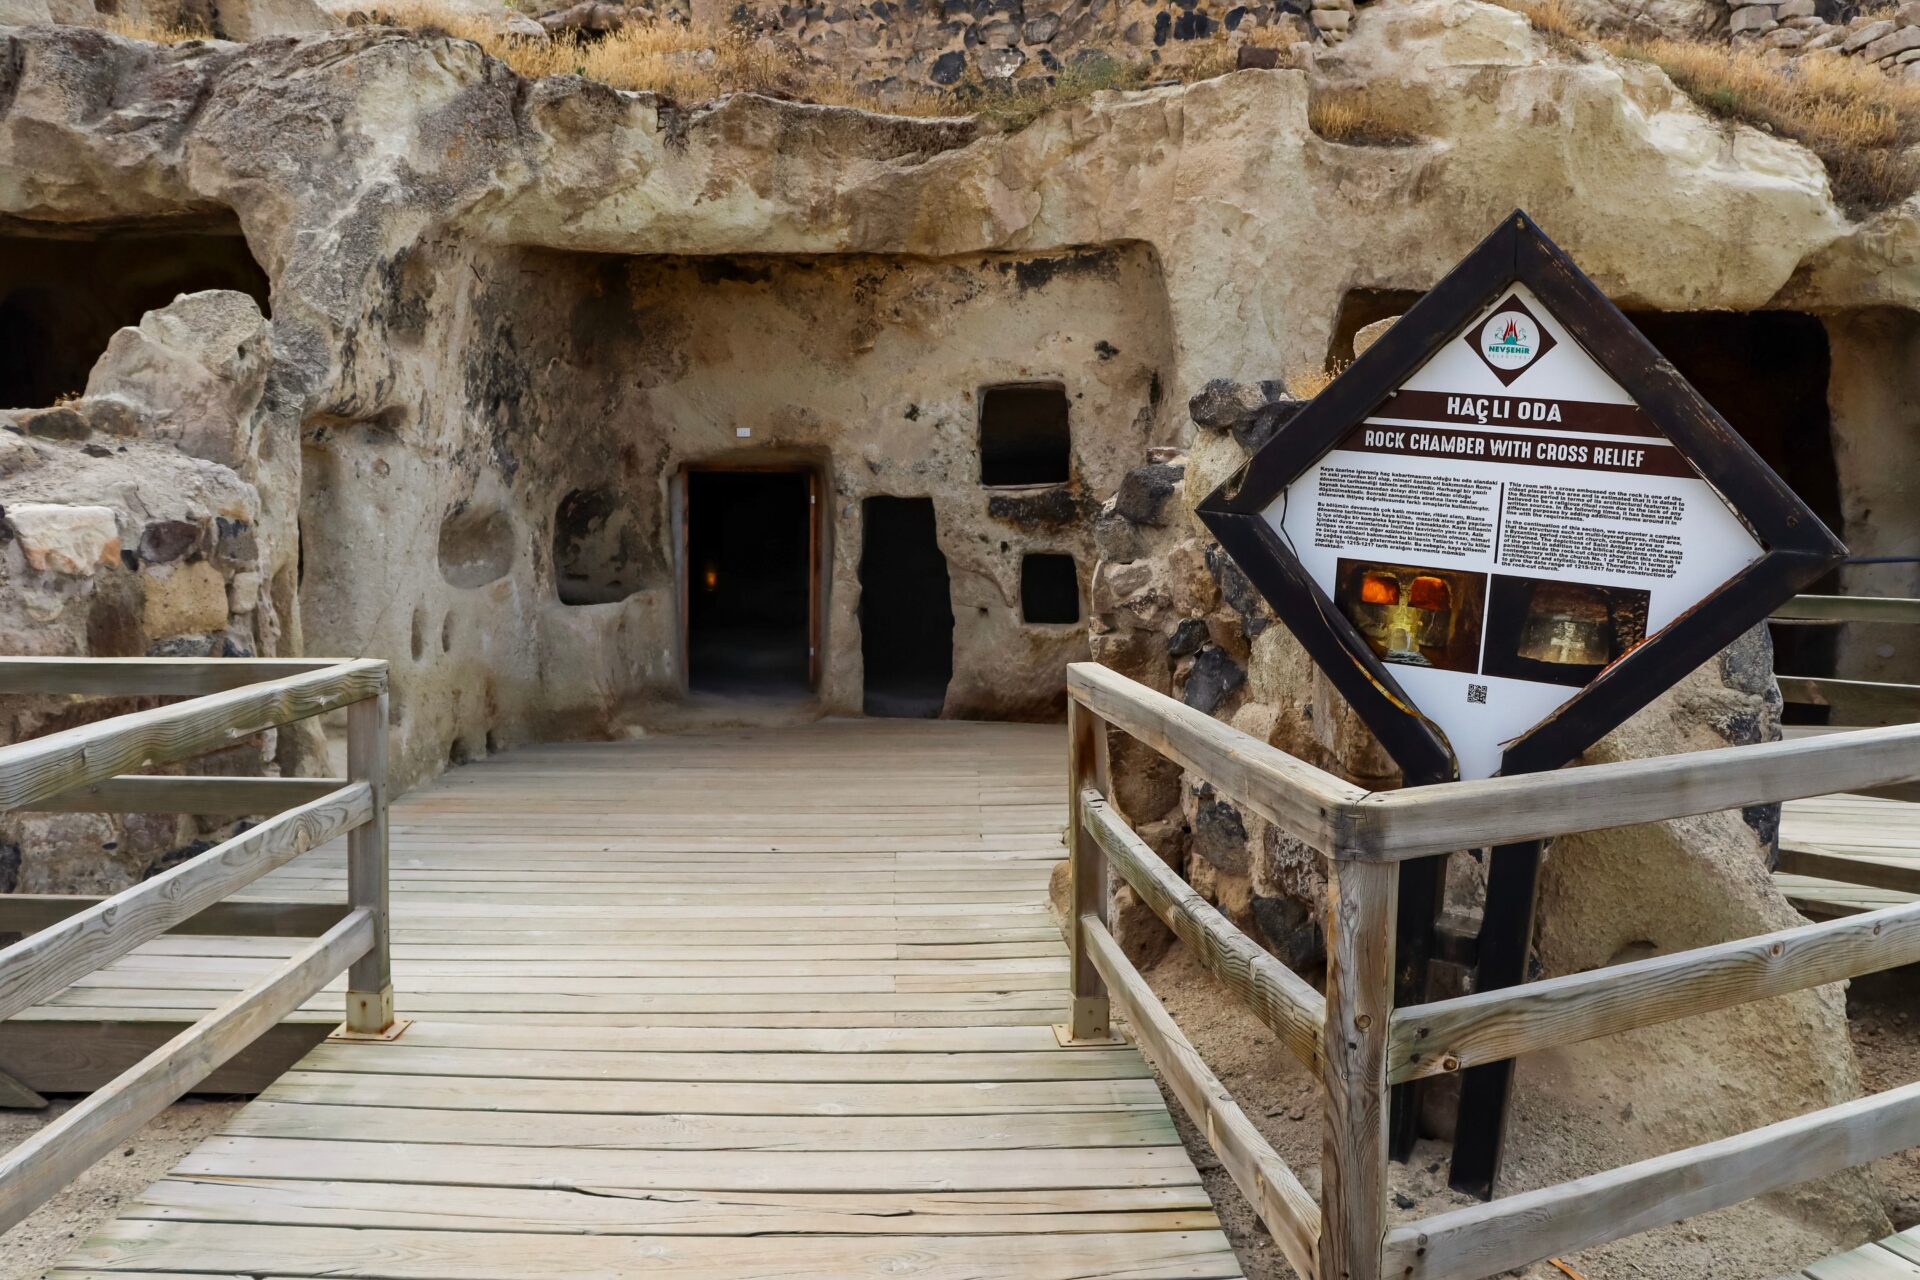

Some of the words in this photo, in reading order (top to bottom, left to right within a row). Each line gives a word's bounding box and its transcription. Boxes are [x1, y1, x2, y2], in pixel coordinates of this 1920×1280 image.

[1447, 397, 1510, 424] HAÇLI
[1518, 402, 1562, 423] ODA
[1366, 431, 1406, 450] ROCK
[1410, 434, 1484, 455] CHAMBER
[1490, 439, 1532, 459] WITH
[1537, 443, 1588, 463] CROSS
[1594, 447, 1645, 468] RELIEF
